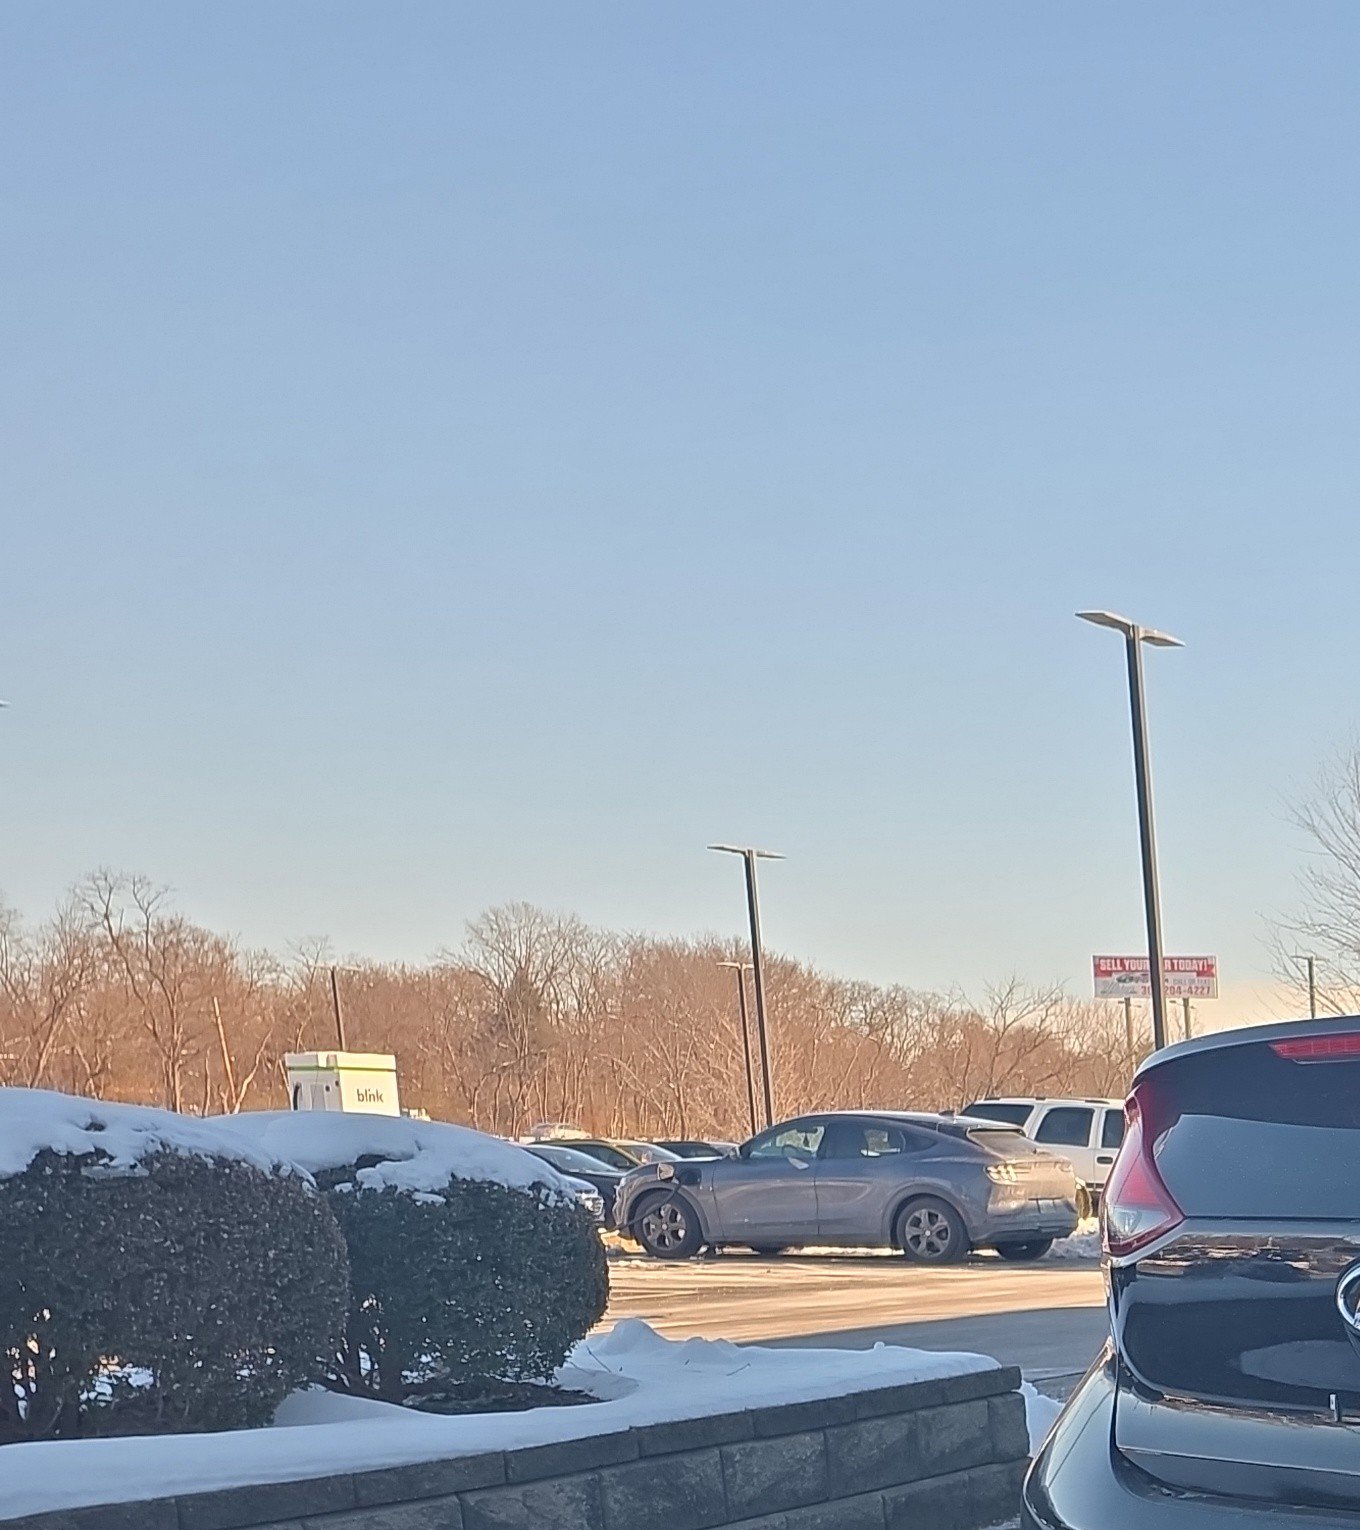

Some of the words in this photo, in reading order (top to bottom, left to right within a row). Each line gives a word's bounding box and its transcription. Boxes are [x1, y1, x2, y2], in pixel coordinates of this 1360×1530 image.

[1100, 959, 1122, 971] SELL
[1124, 959, 1150, 971] YOUR
[1172, 959, 1208, 972] TODAY!
[356, 1088, 384, 1103] blink
